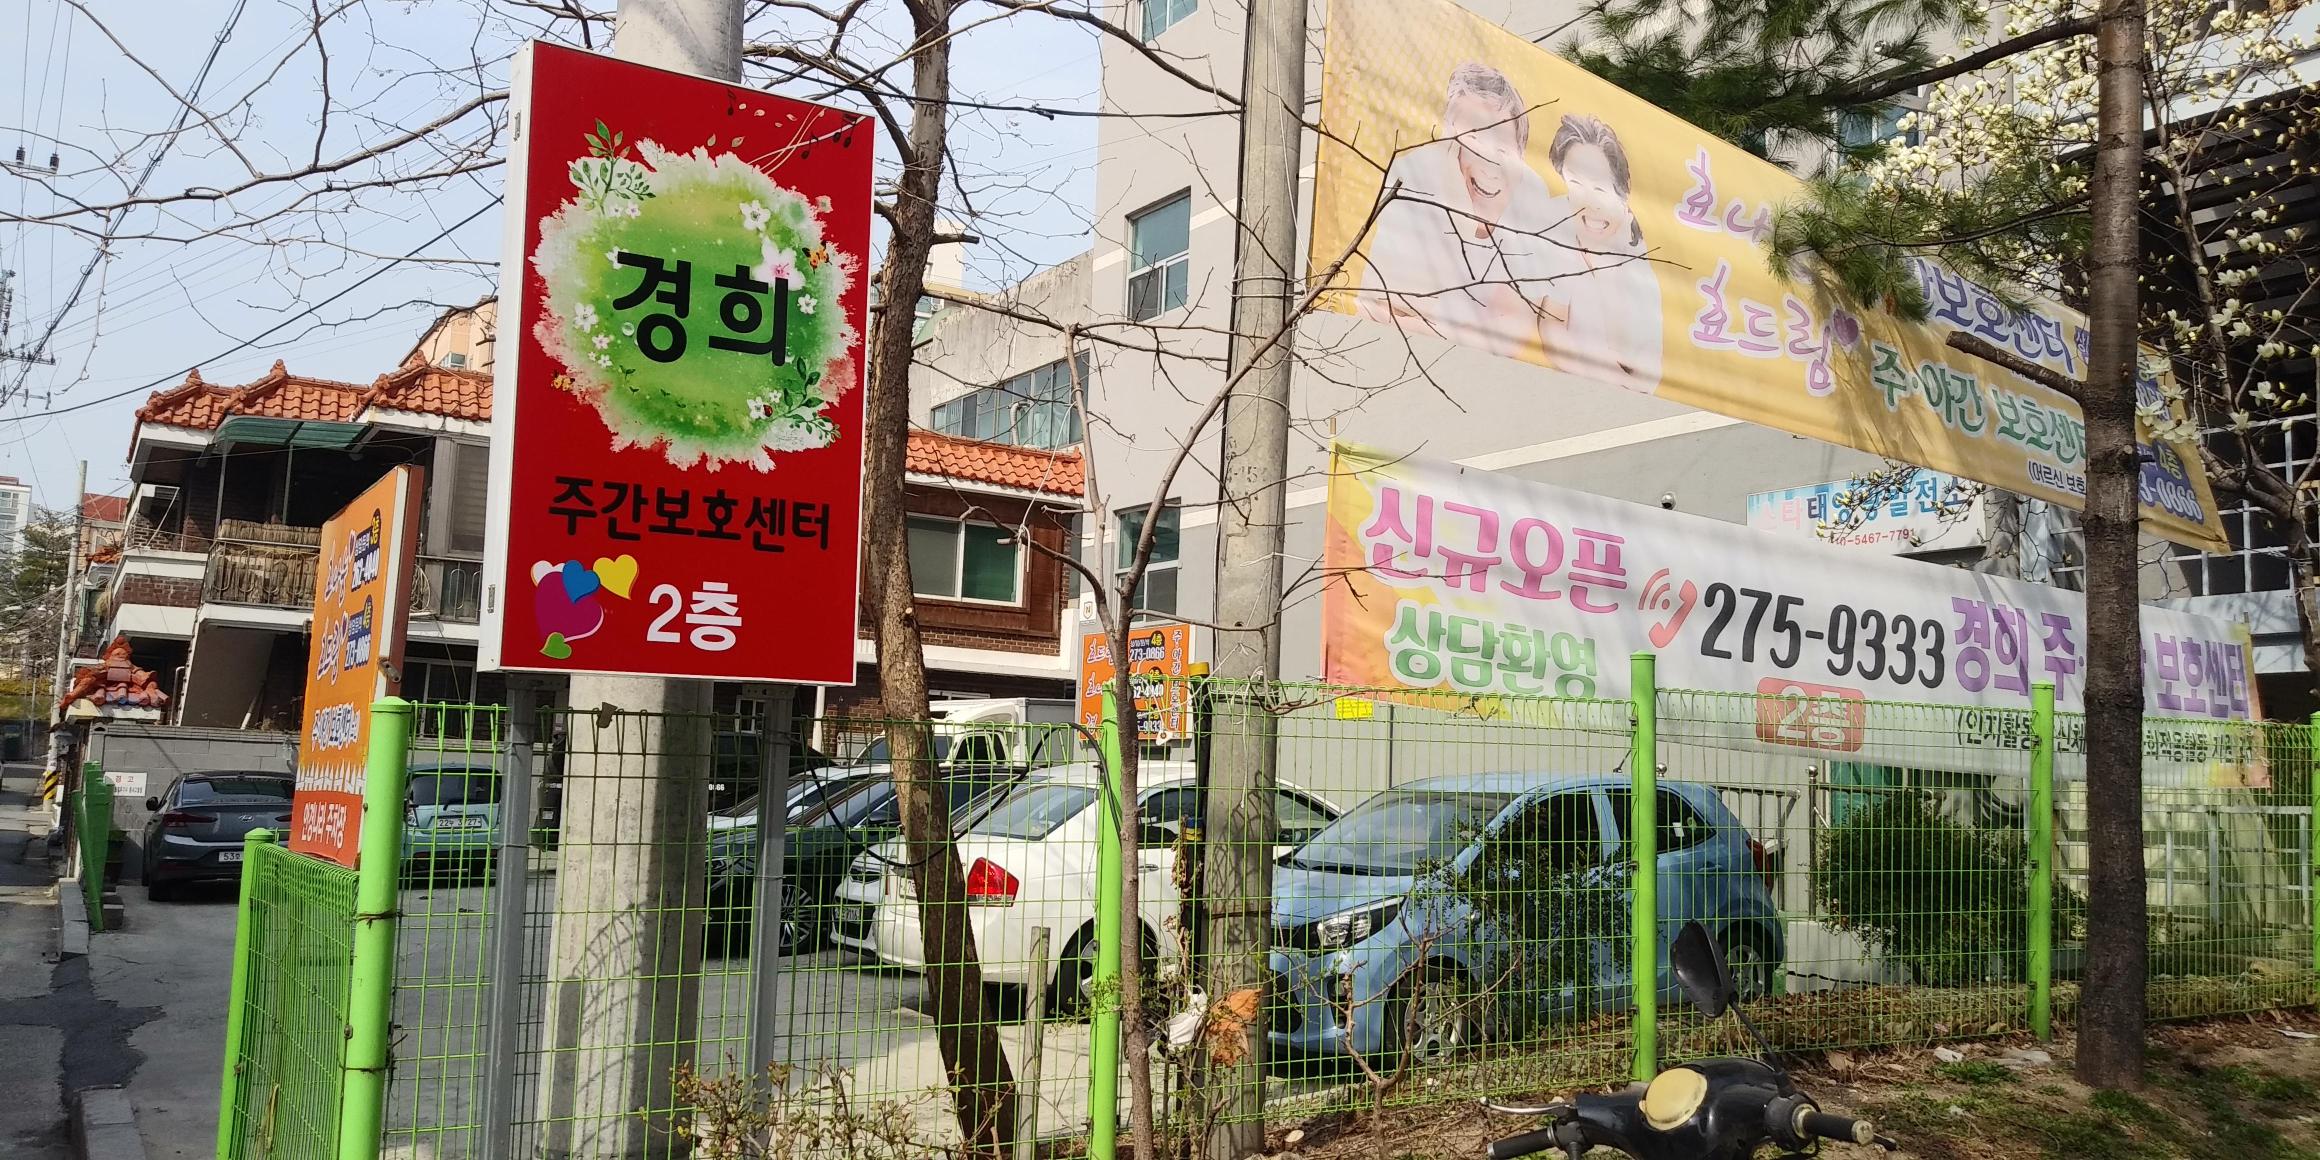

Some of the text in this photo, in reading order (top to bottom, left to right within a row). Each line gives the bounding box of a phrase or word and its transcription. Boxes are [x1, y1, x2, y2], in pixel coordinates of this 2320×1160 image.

[612, 250, 789, 367] 경희
[1693, 264, 1831, 390] 효드림
[1874, 345, 1985, 432] 주·야간
[548, 475, 831, 553] 주간보호센터
[1365, 487, 1627, 614] 신규오픈
[646, 580, 743, 653] 2층
[1130, 647, 1165, 661] 273-0866
[1390, 606, 1598, 701] 상담환영
[1701, 582, 1946, 689] 275-9333
[1952, 596, 2029, 697] 경희
[2154, 633, 2249, 720] 보호센터
[1777, 685, 1850, 746] 2층
[326, 803, 347, 849] 주차장
